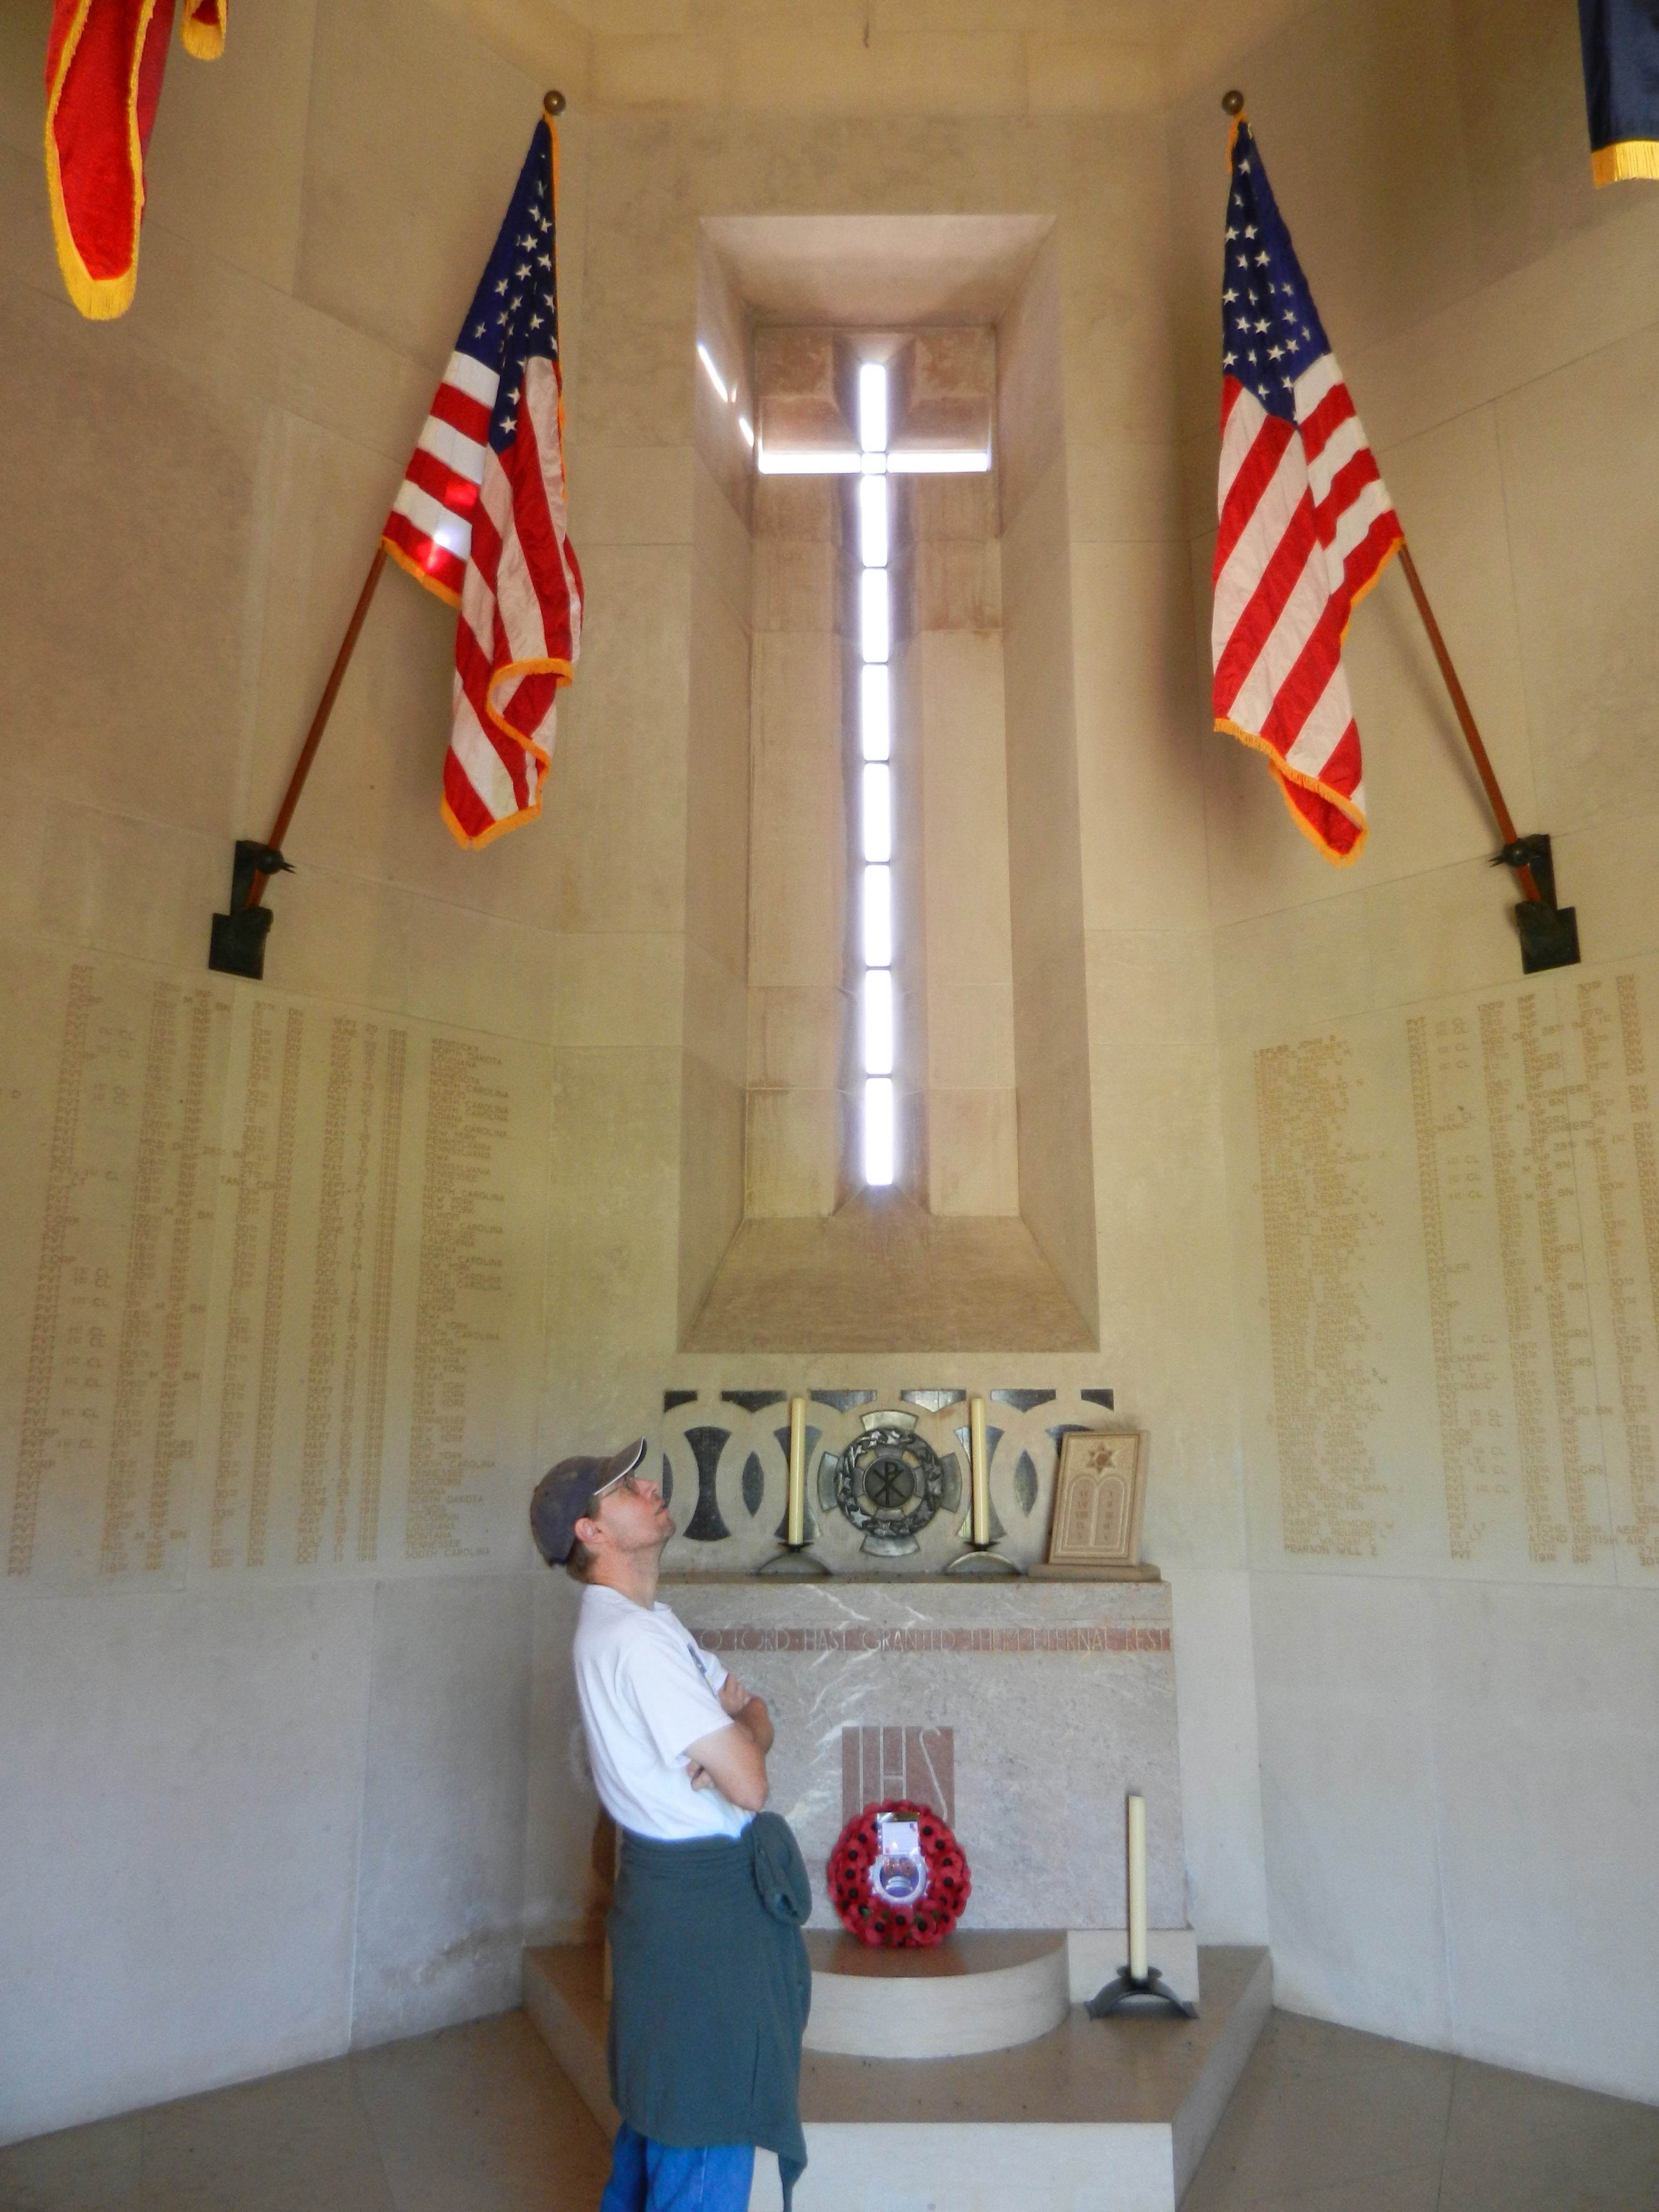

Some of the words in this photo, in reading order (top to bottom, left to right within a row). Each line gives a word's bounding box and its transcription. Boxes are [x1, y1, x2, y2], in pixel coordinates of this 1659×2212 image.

[1616, 974, 1634, 985] DIV
[1435, 1353, 1490, 1364] MECHANIC
[1451, 1550, 1471, 1559] PVT
[1573, 1554, 1592, 1563] INF
[701, 1628, 722, 1651] O
[862, 1628, 956, 1651] GRANTED
[1125, 1627, 1170, 1651] REST
